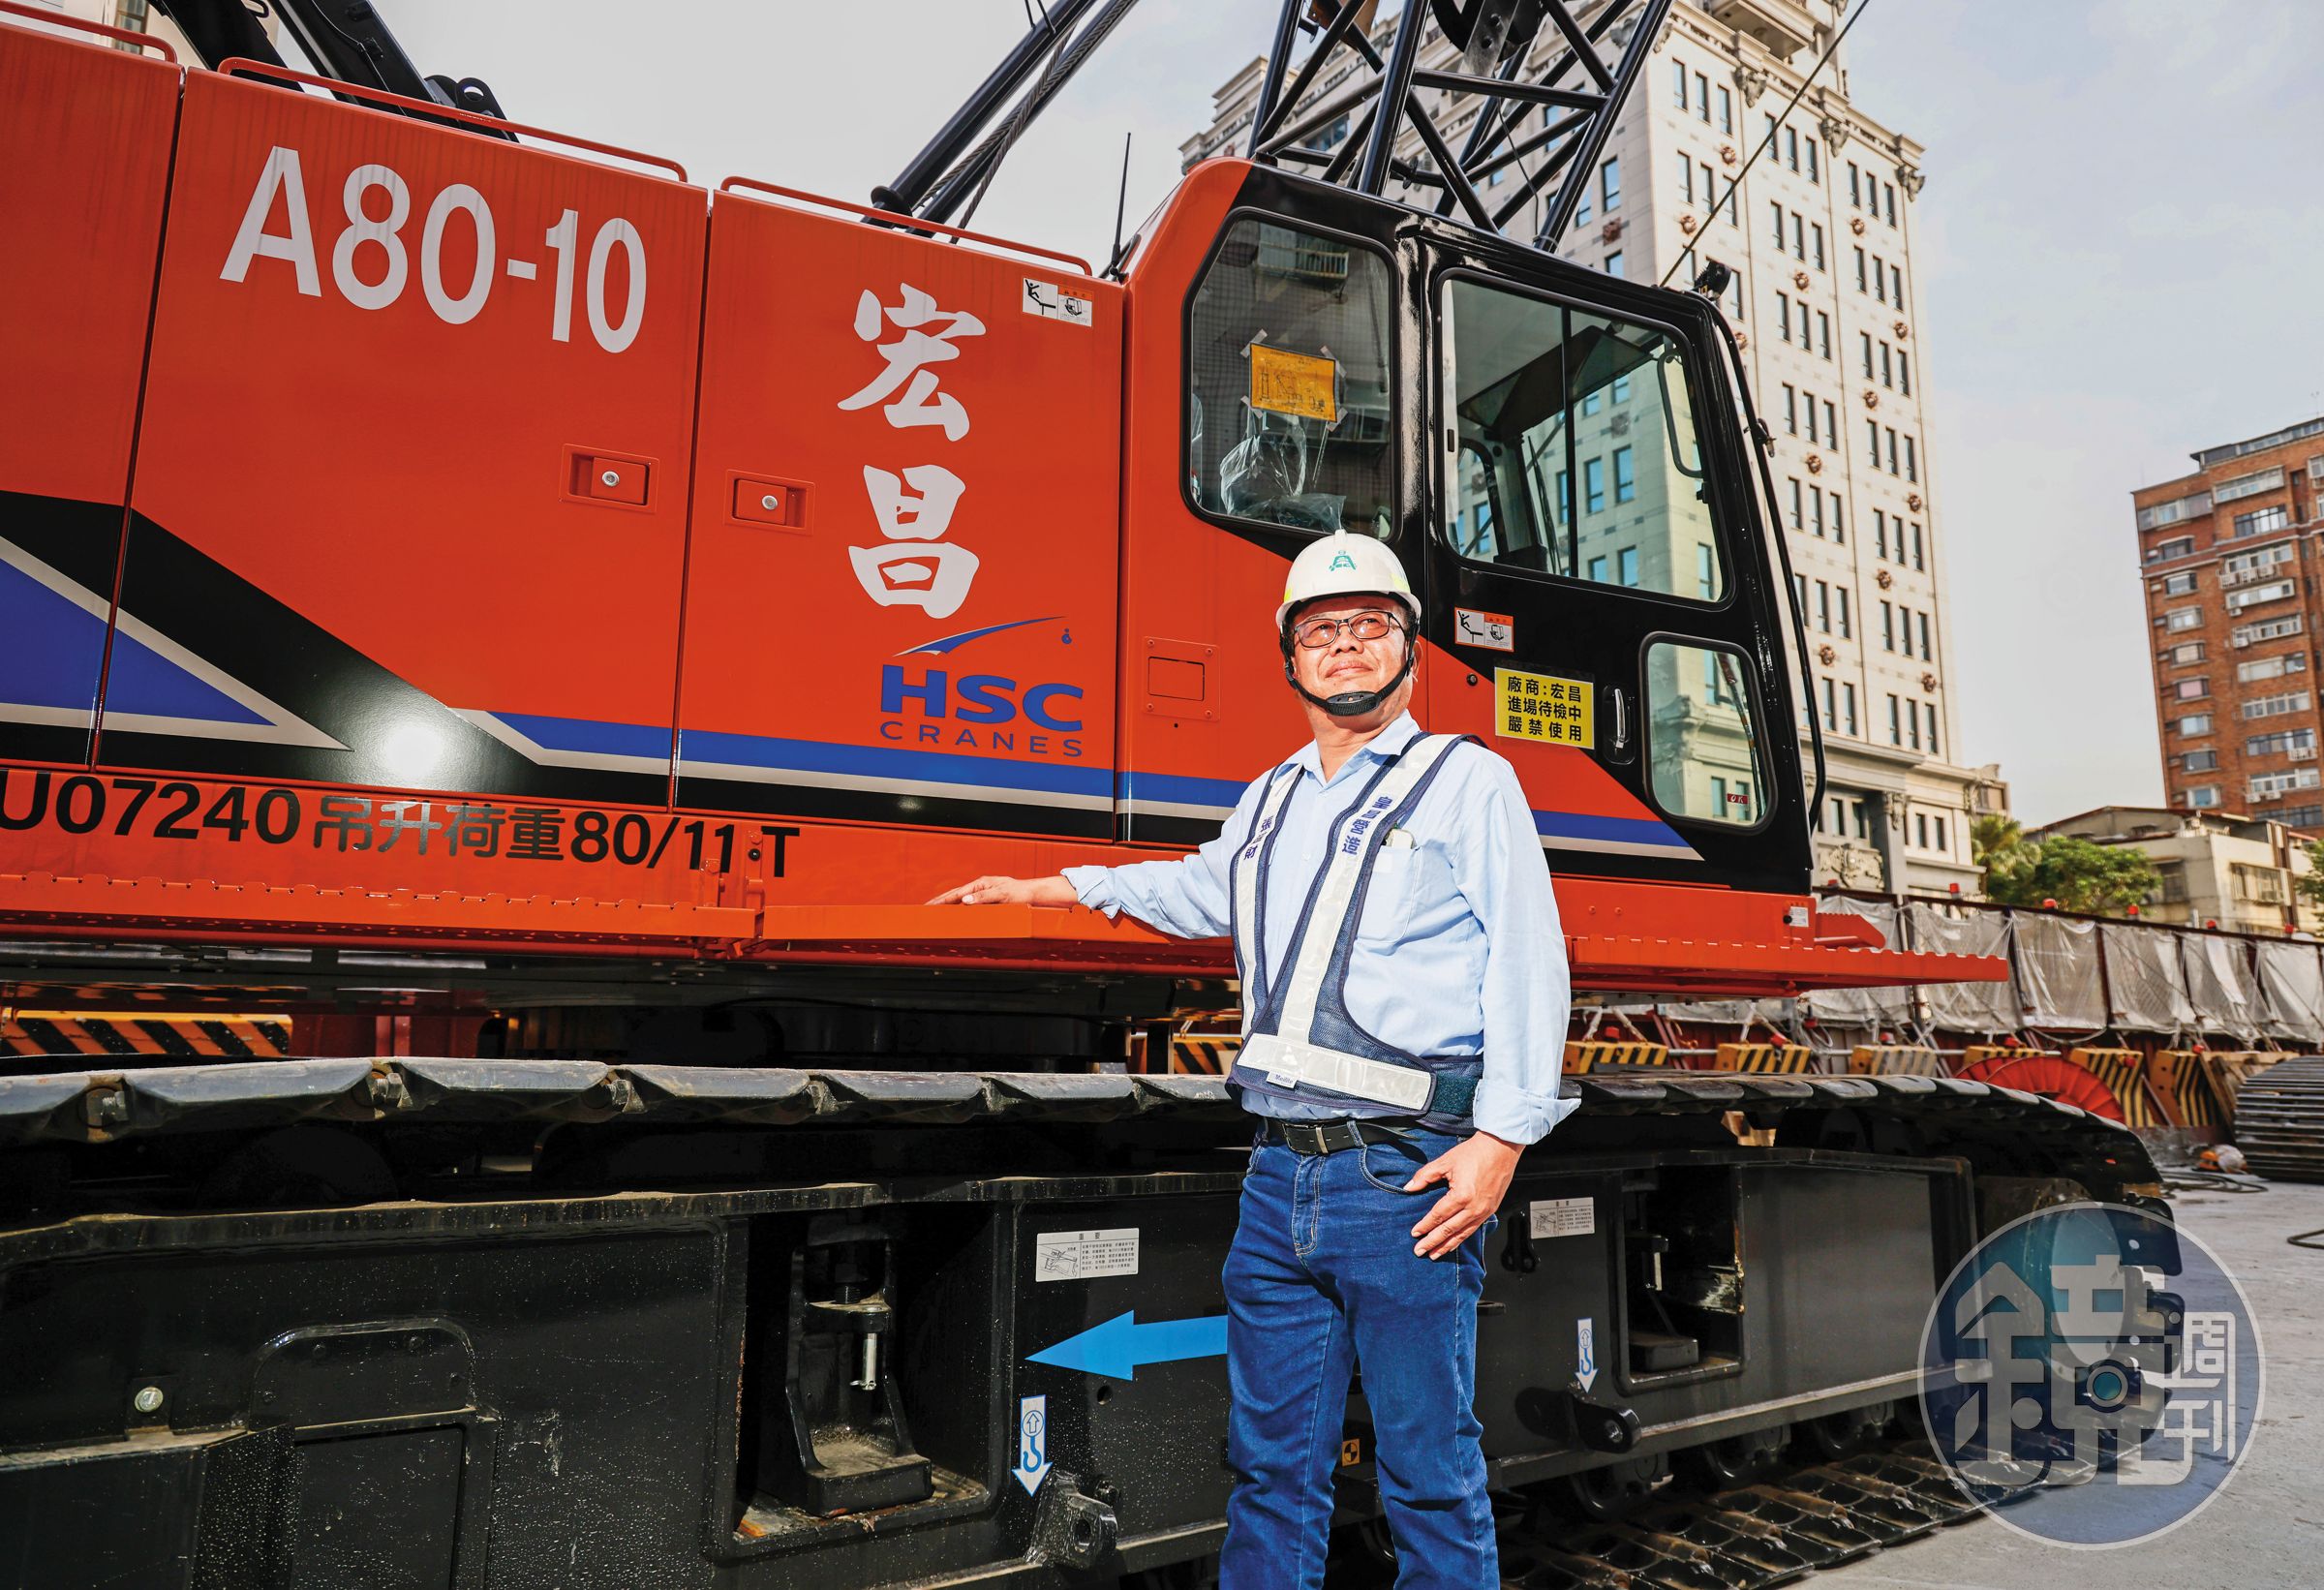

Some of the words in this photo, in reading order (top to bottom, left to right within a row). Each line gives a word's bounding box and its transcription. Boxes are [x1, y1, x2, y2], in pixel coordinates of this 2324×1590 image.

[220, 145, 647, 353] A80-10
[838, 282, 986, 619] 宏昌
[880, 664, 1084, 732] HSC
[1508, 695, 1581, 721] 進場待檢中
[880, 719, 1083, 758] CRANES
[1508, 716, 1581, 742] 嚴禁使用
